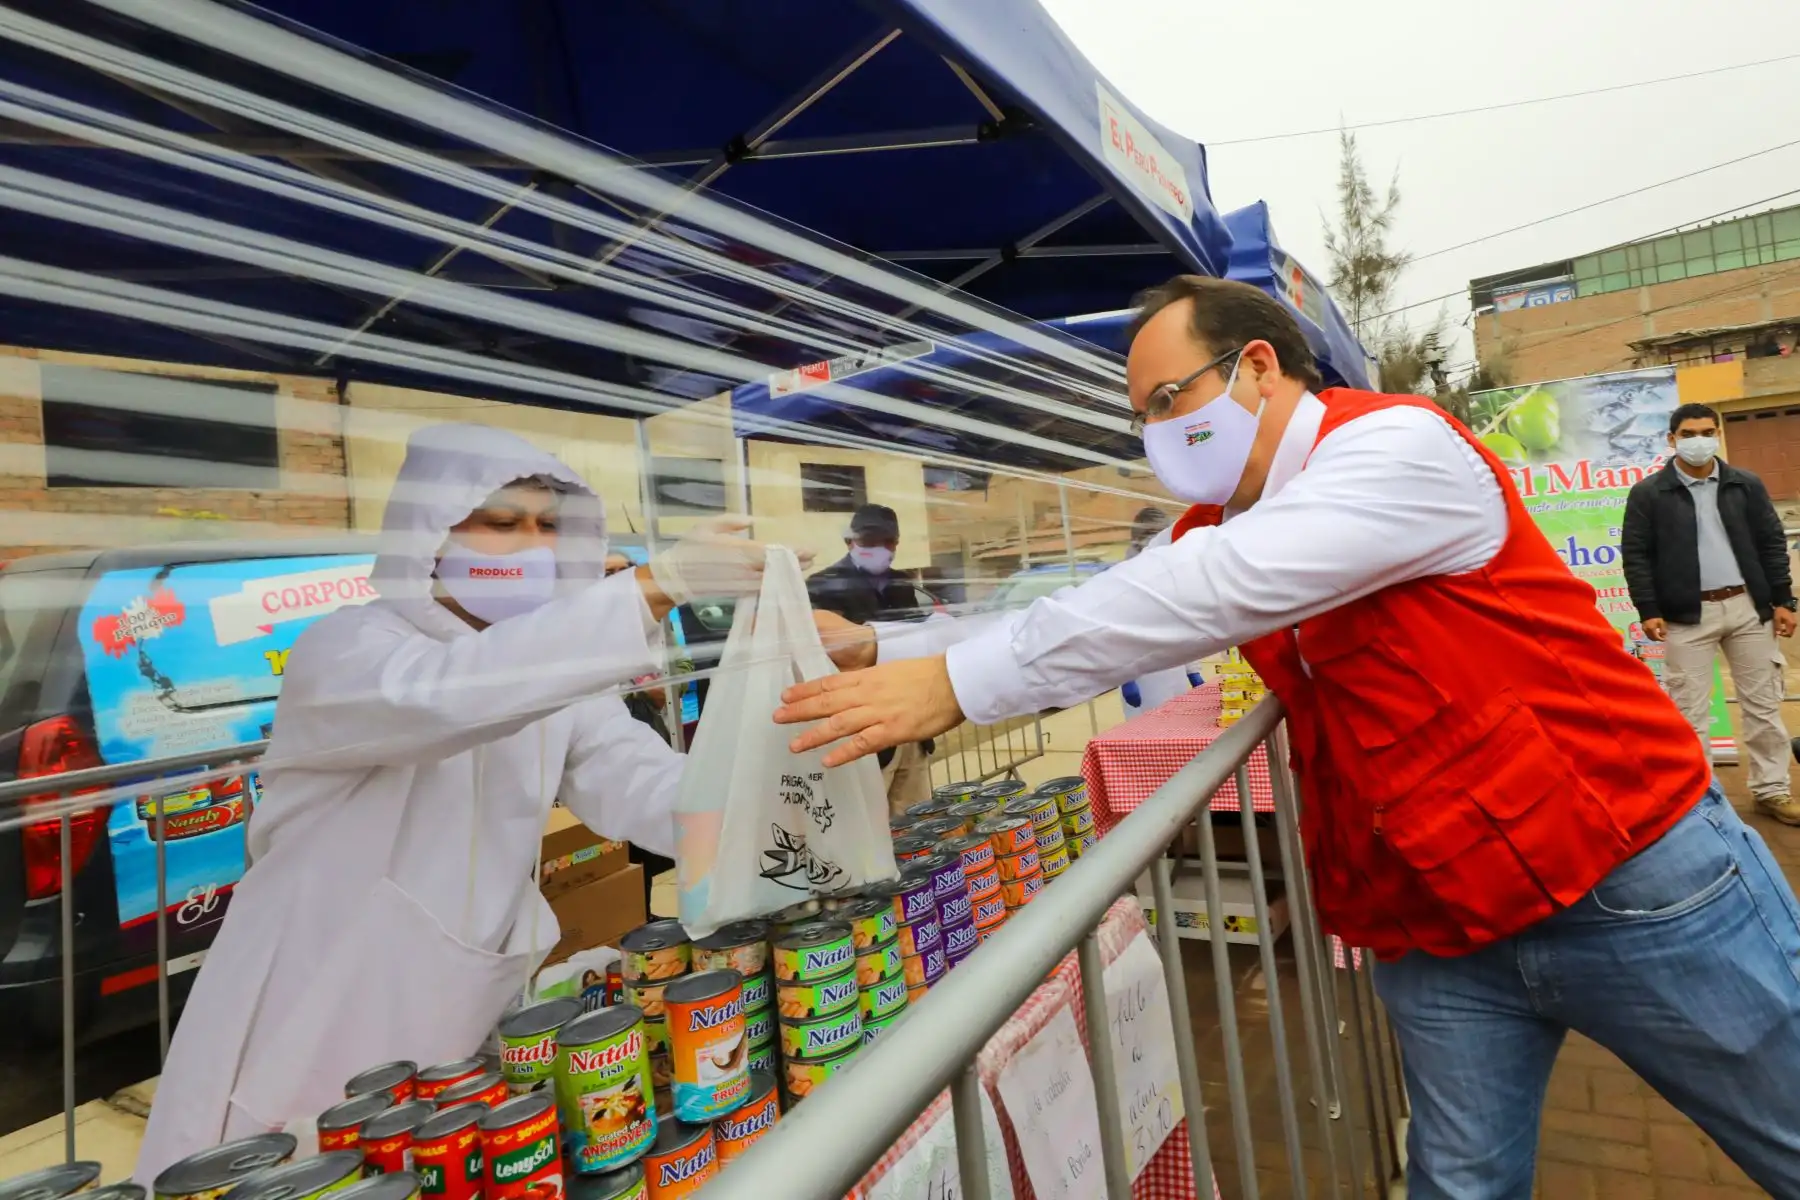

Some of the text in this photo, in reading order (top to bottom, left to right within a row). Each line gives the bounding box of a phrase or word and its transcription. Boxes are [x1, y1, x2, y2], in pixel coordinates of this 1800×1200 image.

[469, 567, 524, 577] PRODUCE
[261, 576, 378, 615] CORPOR
[167, 810, 220, 830] Nataly
[1040, 856, 1068, 873] Kimb
[176, 882, 220, 925] El
[805, 938, 855, 972] Natal
[568, 1030, 643, 1074] Nataly
[512, 1064, 534, 1074] Fish
[600, 1063, 624, 1080] Fish
